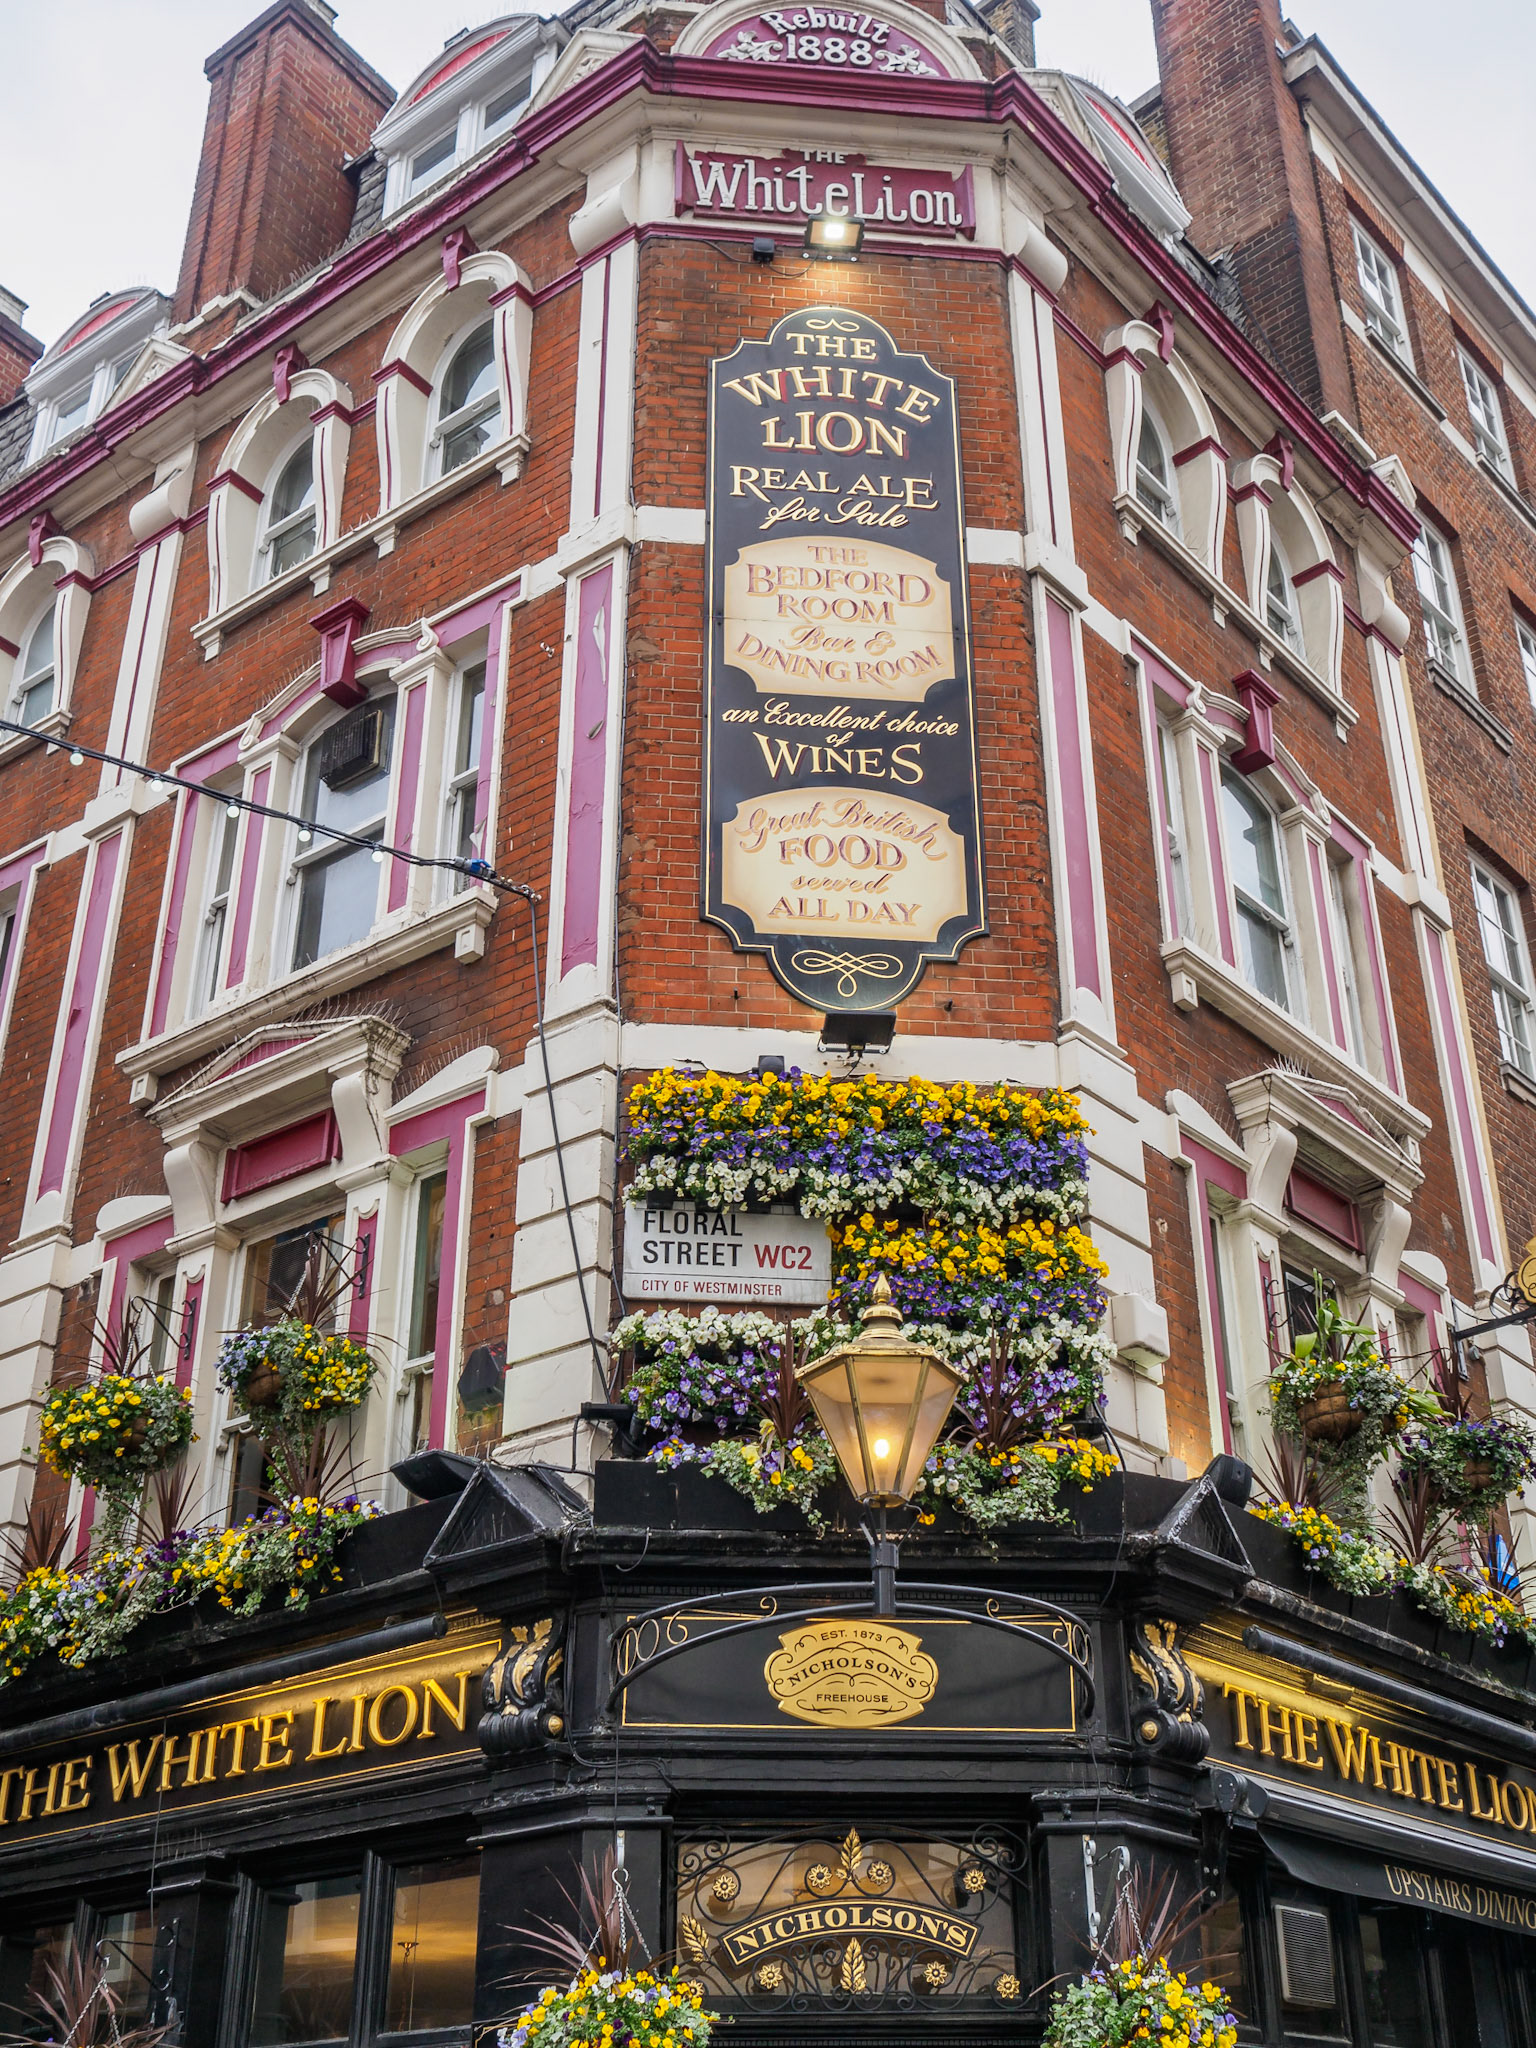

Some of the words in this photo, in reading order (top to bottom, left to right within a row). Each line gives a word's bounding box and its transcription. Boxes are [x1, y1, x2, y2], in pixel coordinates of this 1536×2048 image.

[761, 7, 891, 44] Rebuilt
[786, 33, 873, 66] 1888
[803, 151, 847, 164] THE
[786, 333, 877, 360] THE
[722, 365, 940, 423] WHITE
[761, 411, 906, 456] LION
[729, 465, 840, 503] REAL
[846, 474, 938, 510] ALE
[759, 497, 820, 530] for
[823, 497, 909, 528] Sale
[807, 545, 868, 567] THE
[747, 563, 936, 606] BEDFORD
[777, 593, 897, 625] ROOM
[779, 626, 856, 652] Bar
[864, 629, 897, 657] &
[737, 632, 848, 682] DINING
[855, 645, 944, 690] ROOM
[721, 708, 758, 723] an
[764, 697, 887, 730] Excellent
[885, 710, 959, 736] choice
[826, 731, 854, 748] of
[753, 731, 924, 785] WINES
[733, 801, 826, 850] Great
[823, 798, 947, 860] British
[778, 834, 907, 870] FOOD
[790, 872, 893, 894] served
[768, 896, 840, 921] ALL
[848, 900, 923, 926] DAY
[643, 1210, 743, 1237] FLORAL
[643, 1240, 743, 1267] STREET
[754, 1244, 813, 1270] WC2
[641, 1279, 669, 1292] CITY
[674, 1282, 689, 1293] OF
[693, 1282, 782, 1296] WESTMINSTER
[820, 1629, 848, 1641] EST.
[854, 1630, 883, 1642] 1873
[787, 1657, 917, 1688] NICHOLSON'S
[816, 1694, 889, 1703] FREEHOUSE
[0, 1754, 93, 1826] THE
[103, 1708, 294, 1803] WHITE
[305, 1670, 472, 1762] LION
[1222, 1681, 1324, 1771] THE
[1324, 1714, 1464, 1813] WHITE
[1383, 1864, 1472, 1914] UPSTAIRS
[1475, 1886, 1536, 1930] DINING
[732, 1906, 968, 1957] NICHOLSON'S
